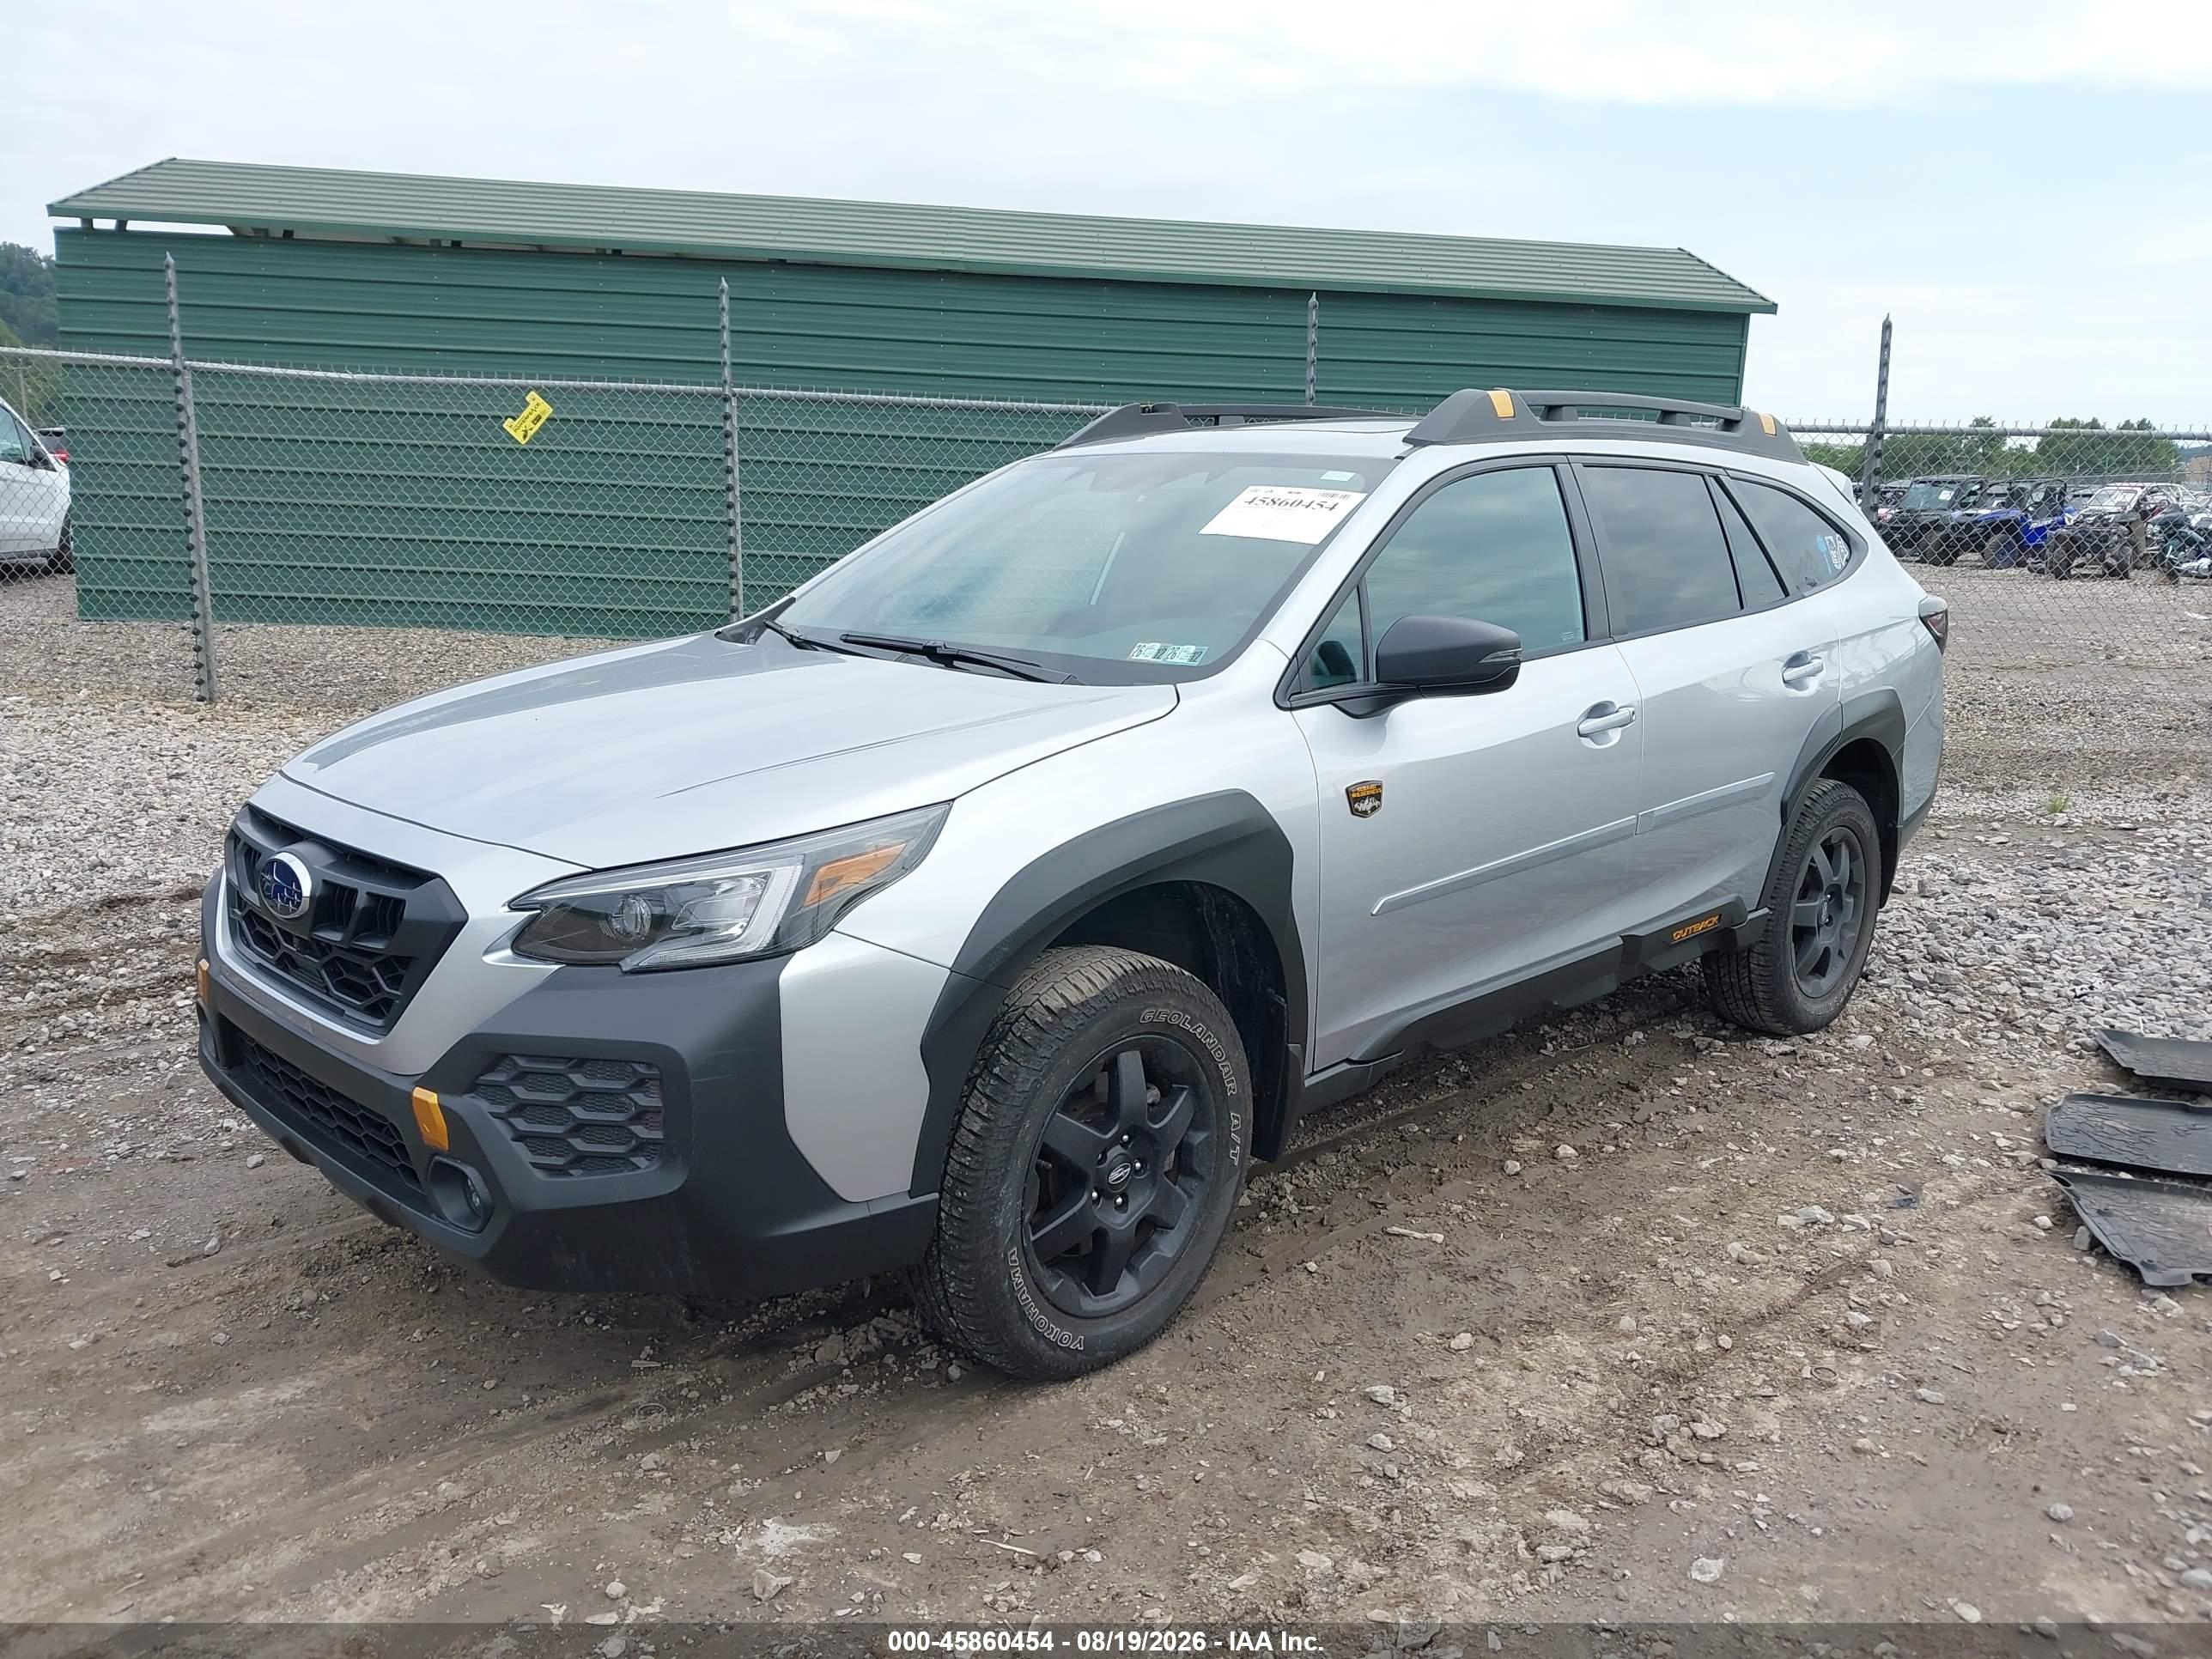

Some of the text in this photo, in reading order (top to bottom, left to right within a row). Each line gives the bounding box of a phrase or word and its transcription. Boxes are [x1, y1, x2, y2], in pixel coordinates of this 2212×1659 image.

[1243, 495, 1340, 512] 45860454
[1131, 644, 1168, 659] 26 12
[1164, 647, 1202, 663] 26 12
[1672, 915, 1719, 940] OUTBACK
[1139, 1009, 1243, 1166] GEOLANDAR A/T
[1007, 1247, 1085, 1352] YOKOHAMA
